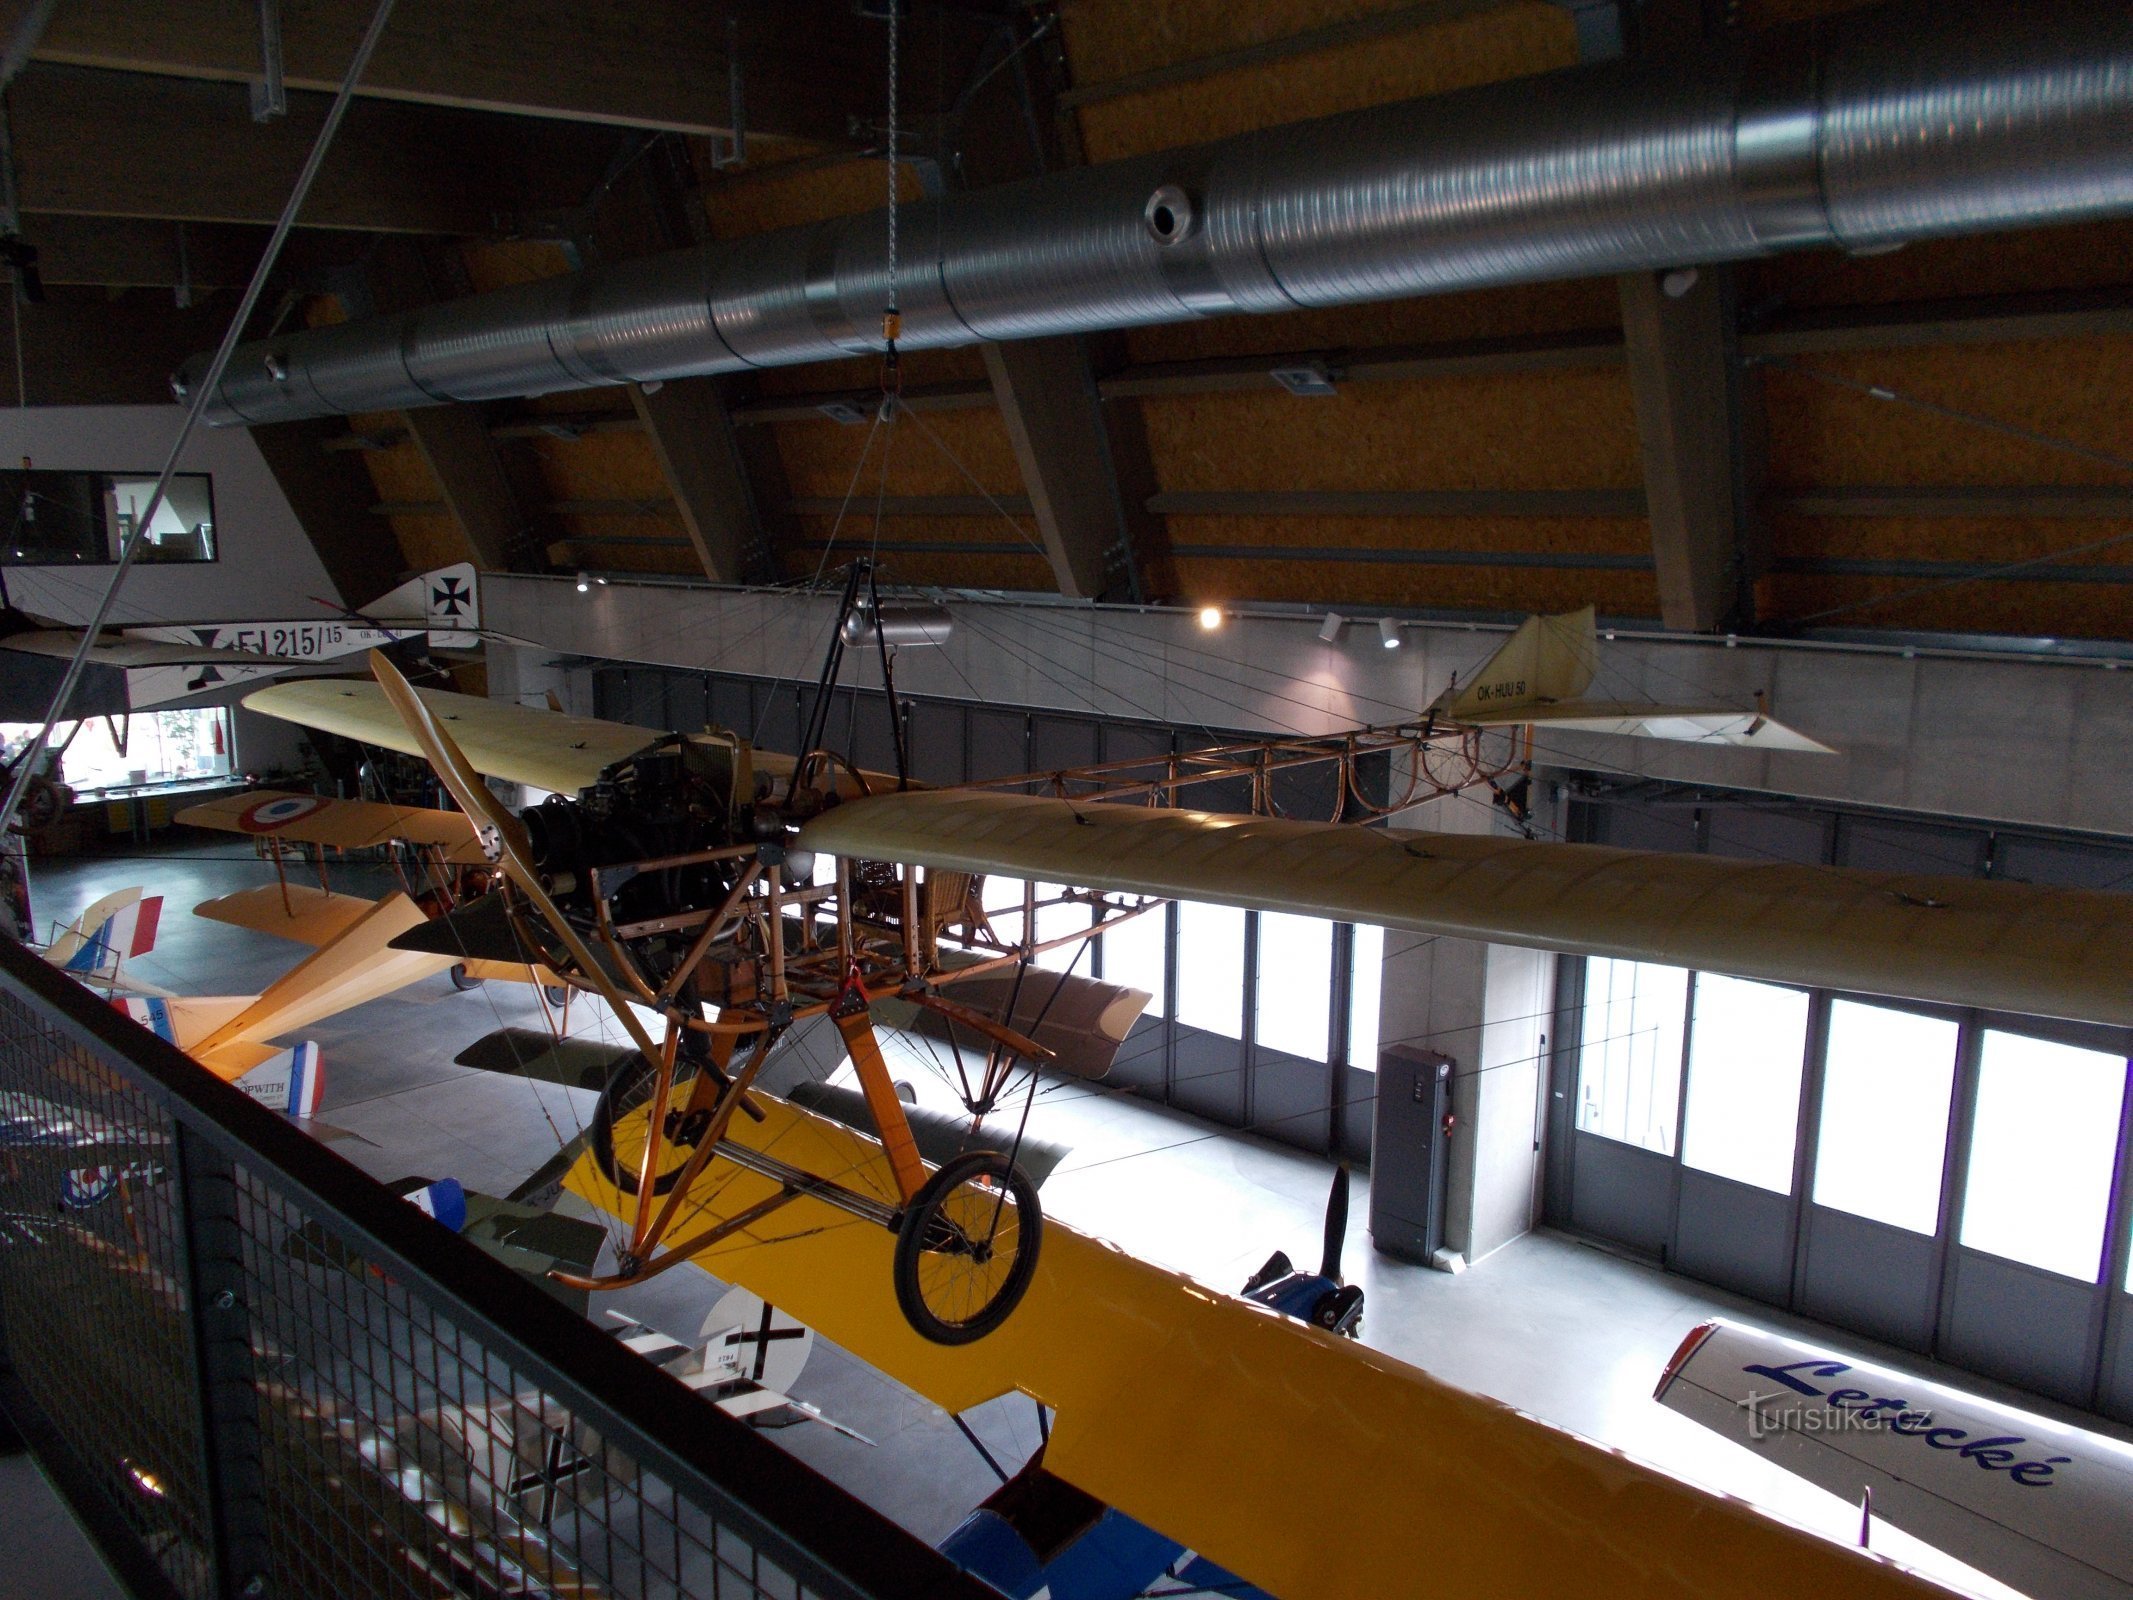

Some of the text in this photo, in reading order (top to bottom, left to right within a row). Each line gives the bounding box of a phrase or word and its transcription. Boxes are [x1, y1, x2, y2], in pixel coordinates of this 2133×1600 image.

[1515, 681, 1526, 695] 50
[240, 1082, 285, 1096] OPWITH
[1743, 1360, 2073, 1487] Letecké
